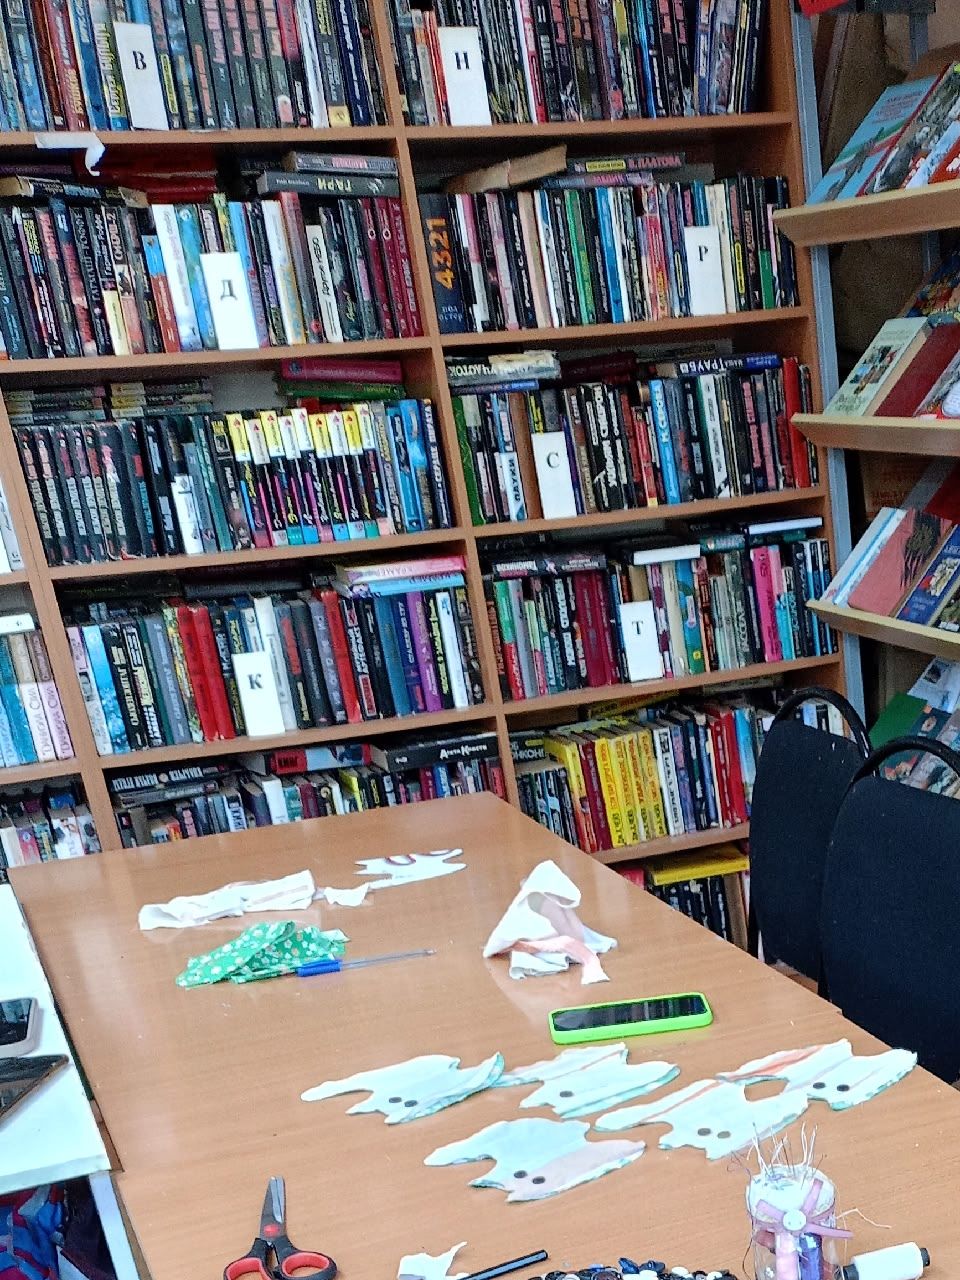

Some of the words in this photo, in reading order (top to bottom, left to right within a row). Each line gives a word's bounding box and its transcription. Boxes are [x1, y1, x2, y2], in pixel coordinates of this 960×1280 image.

[133, 50, 147, 70] В
[317, 176, 352, 193] ГАРИ
[426, 218, 454, 288] 4321
[698, 244, 709, 262] Р
[220, 279, 236, 300] Д
[547, 450, 561, 470] С
[632, 619, 644, 636] Т
[247, 672, 263, 691] К
